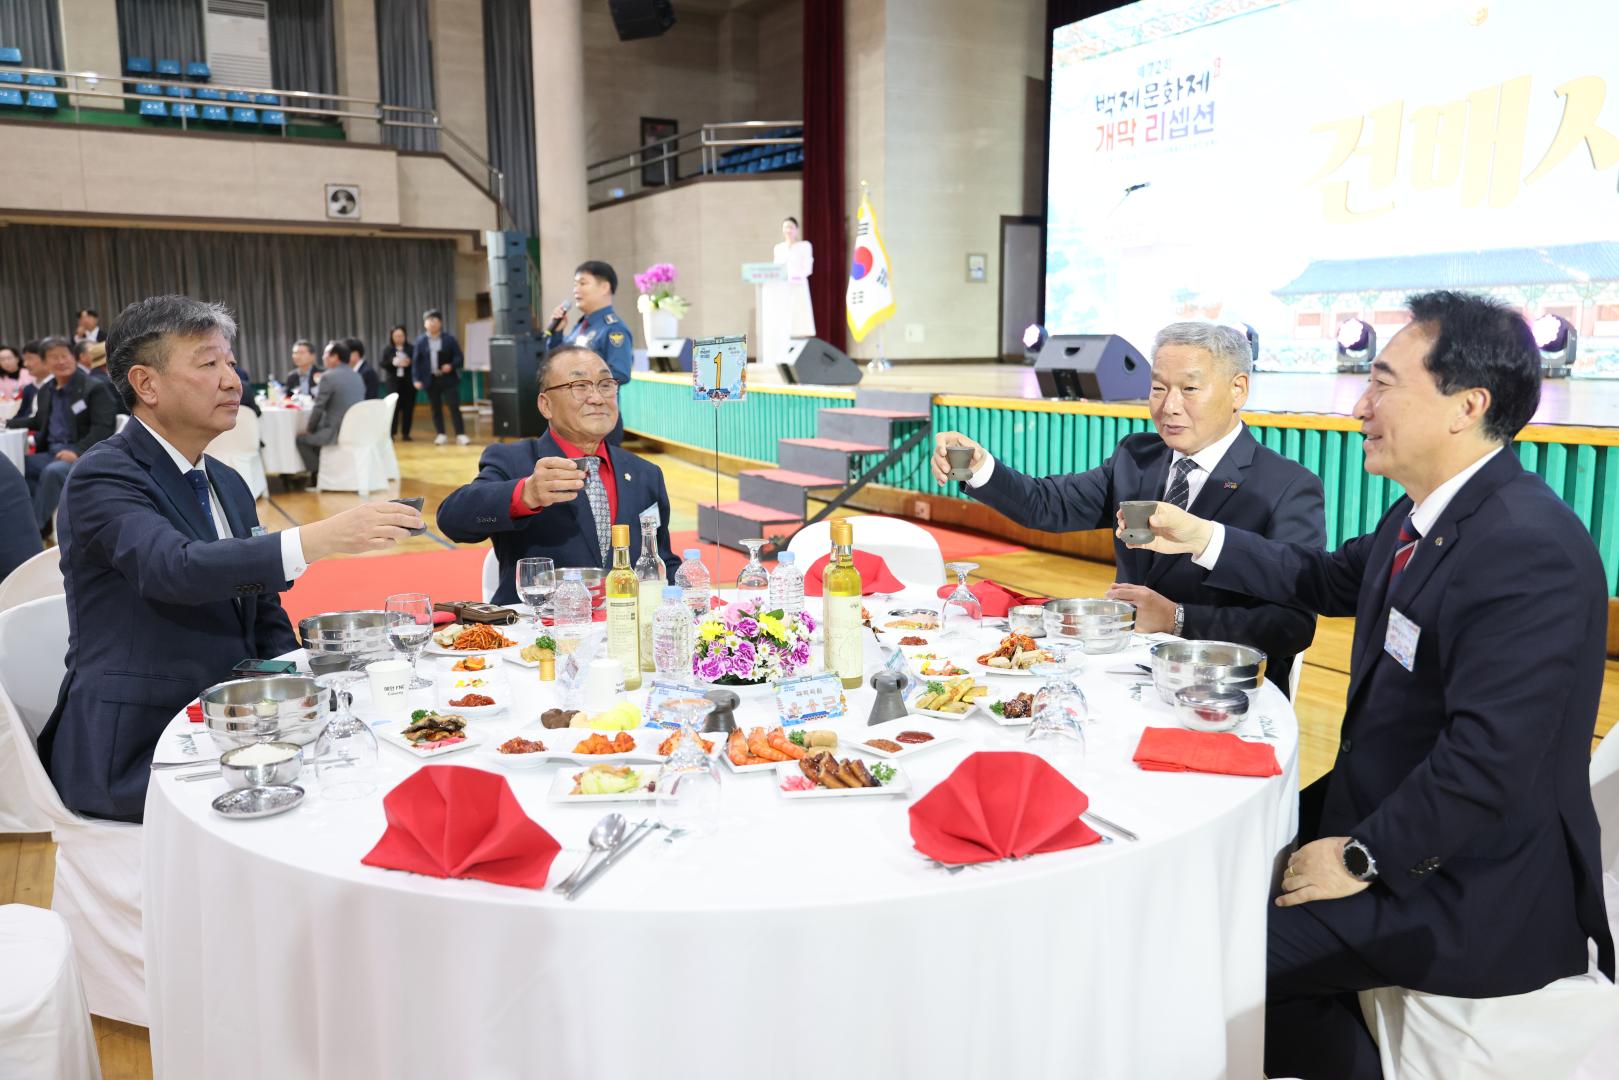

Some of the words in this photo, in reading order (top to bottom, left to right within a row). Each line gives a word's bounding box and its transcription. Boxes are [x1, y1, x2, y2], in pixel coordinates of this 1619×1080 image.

[1095, 70, 1210, 119] 백제문화제
[1096, 117, 1137, 152] 개막
[1145, 100, 1215, 143] 리셉션
[714, 352, 721, 390] 1
